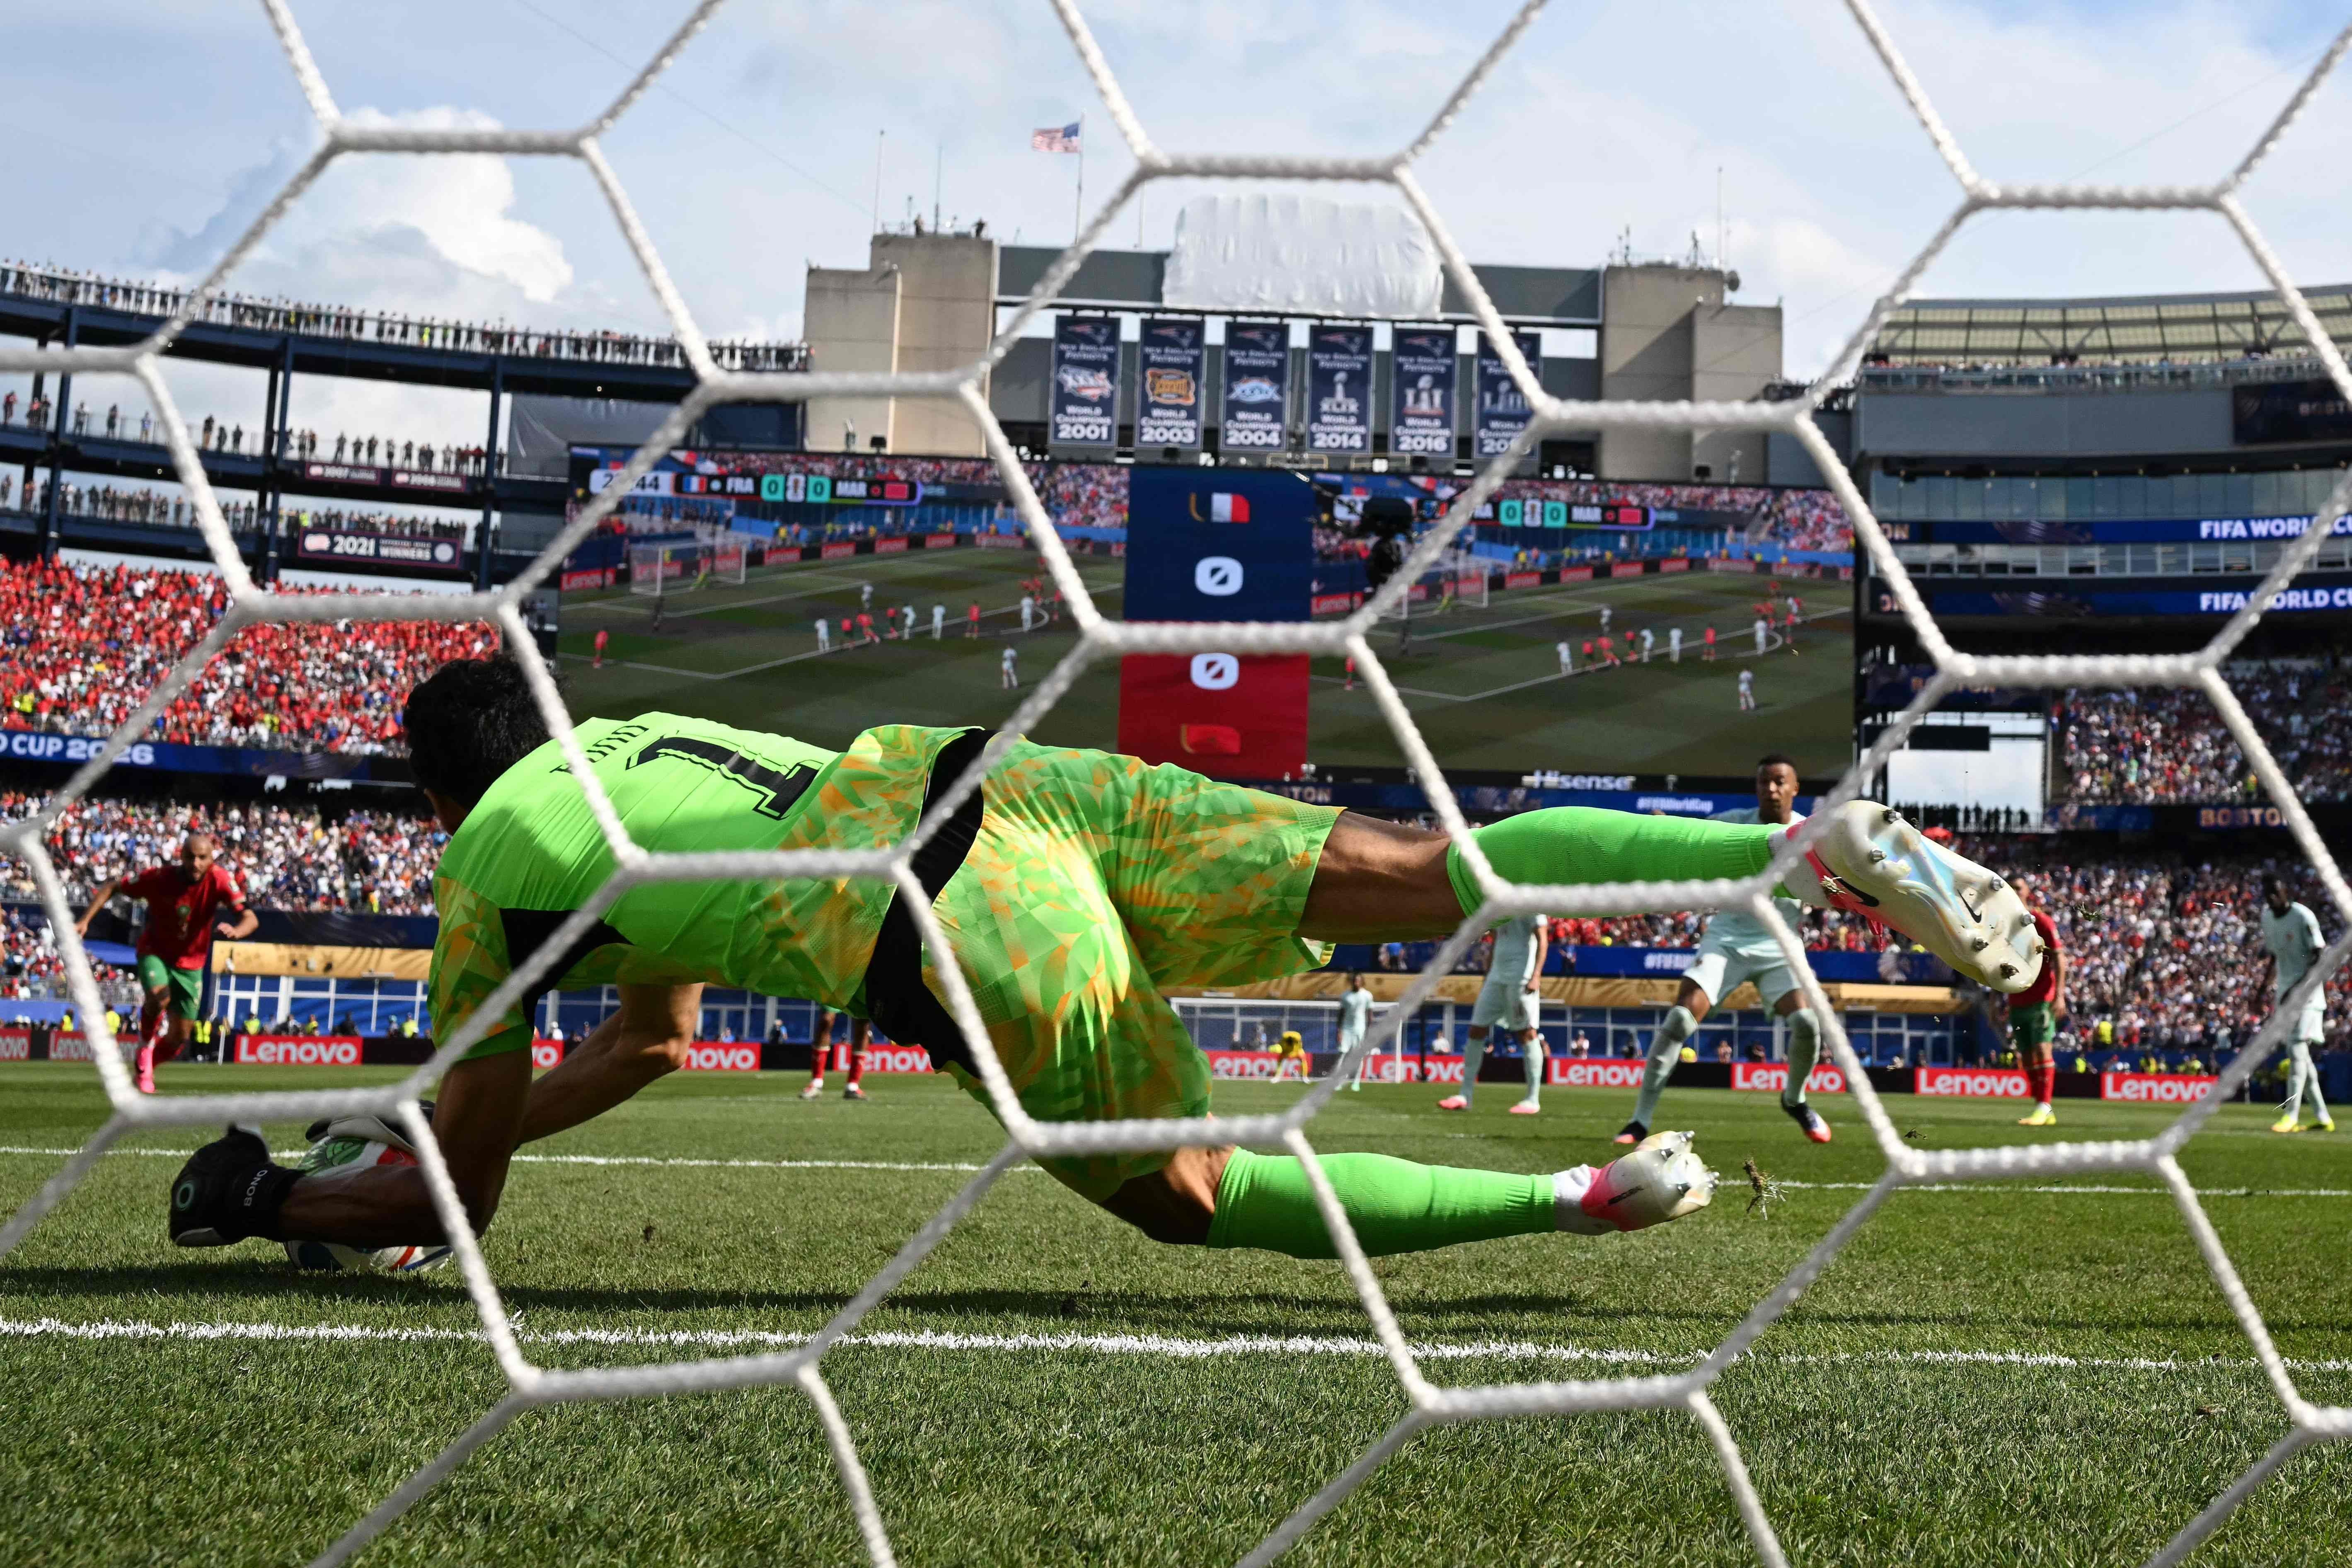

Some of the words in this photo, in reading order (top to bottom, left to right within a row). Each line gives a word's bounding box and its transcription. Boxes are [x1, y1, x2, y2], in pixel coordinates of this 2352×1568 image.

[1057, 424, 1108, 440] 2001
[1141, 427, 1195, 443] 2003
[1226, 430, 1280, 446] 2004
[1313, 432, 1363, 449] 2014
[1398, 436, 1447, 452] 2016
[726, 477, 754, 494] FRA
[836, 481, 868, 497] MAR
[2200, 520, 2248, 539] FIFA
[2249, 516, 2318, 537] WORL
[333, 535, 375, 556] 2021
[2200, 593, 2246, 611] FIFA
[2250, 589, 2330, 610] ORLD
[12, 733, 63, 757] CUP
[625, 731, 824, 820] 1
[1534, 770, 1631, 790] Hisense
[239, 1036, 357, 1064] Lenovo
[1552, 1061, 1645, 1086] Lenov
[1736, 1066, 1844, 1091] Lenvo
[1919, 1068, 2026, 1096] Lenovo
[243, 1170, 268, 1206] BONO
